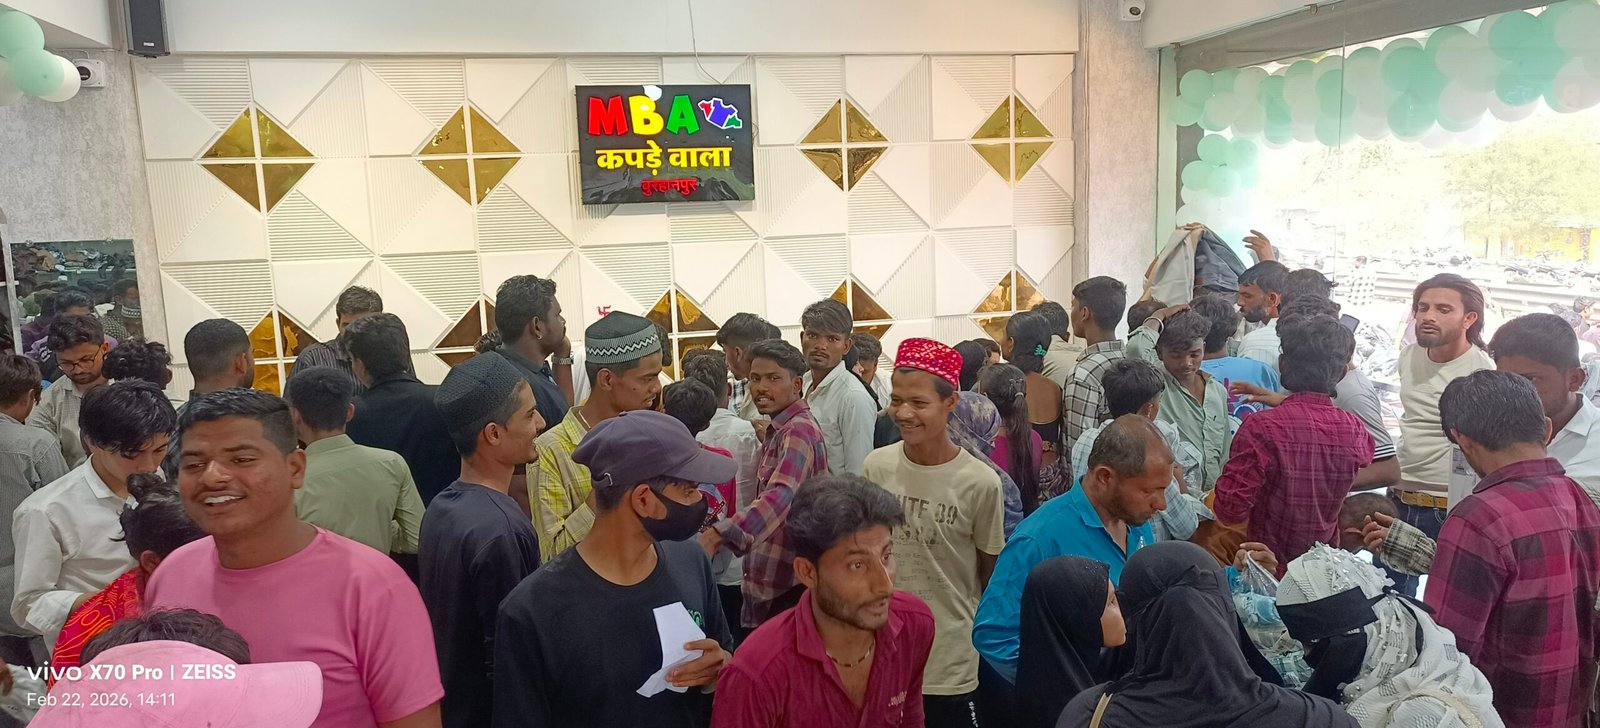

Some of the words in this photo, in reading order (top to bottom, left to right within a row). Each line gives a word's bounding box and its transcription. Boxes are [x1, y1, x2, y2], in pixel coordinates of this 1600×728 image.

[588, 94, 700, 136] MBA
[595, 140, 662, 176] कपड़े
[667, 147, 732, 168] वाला
